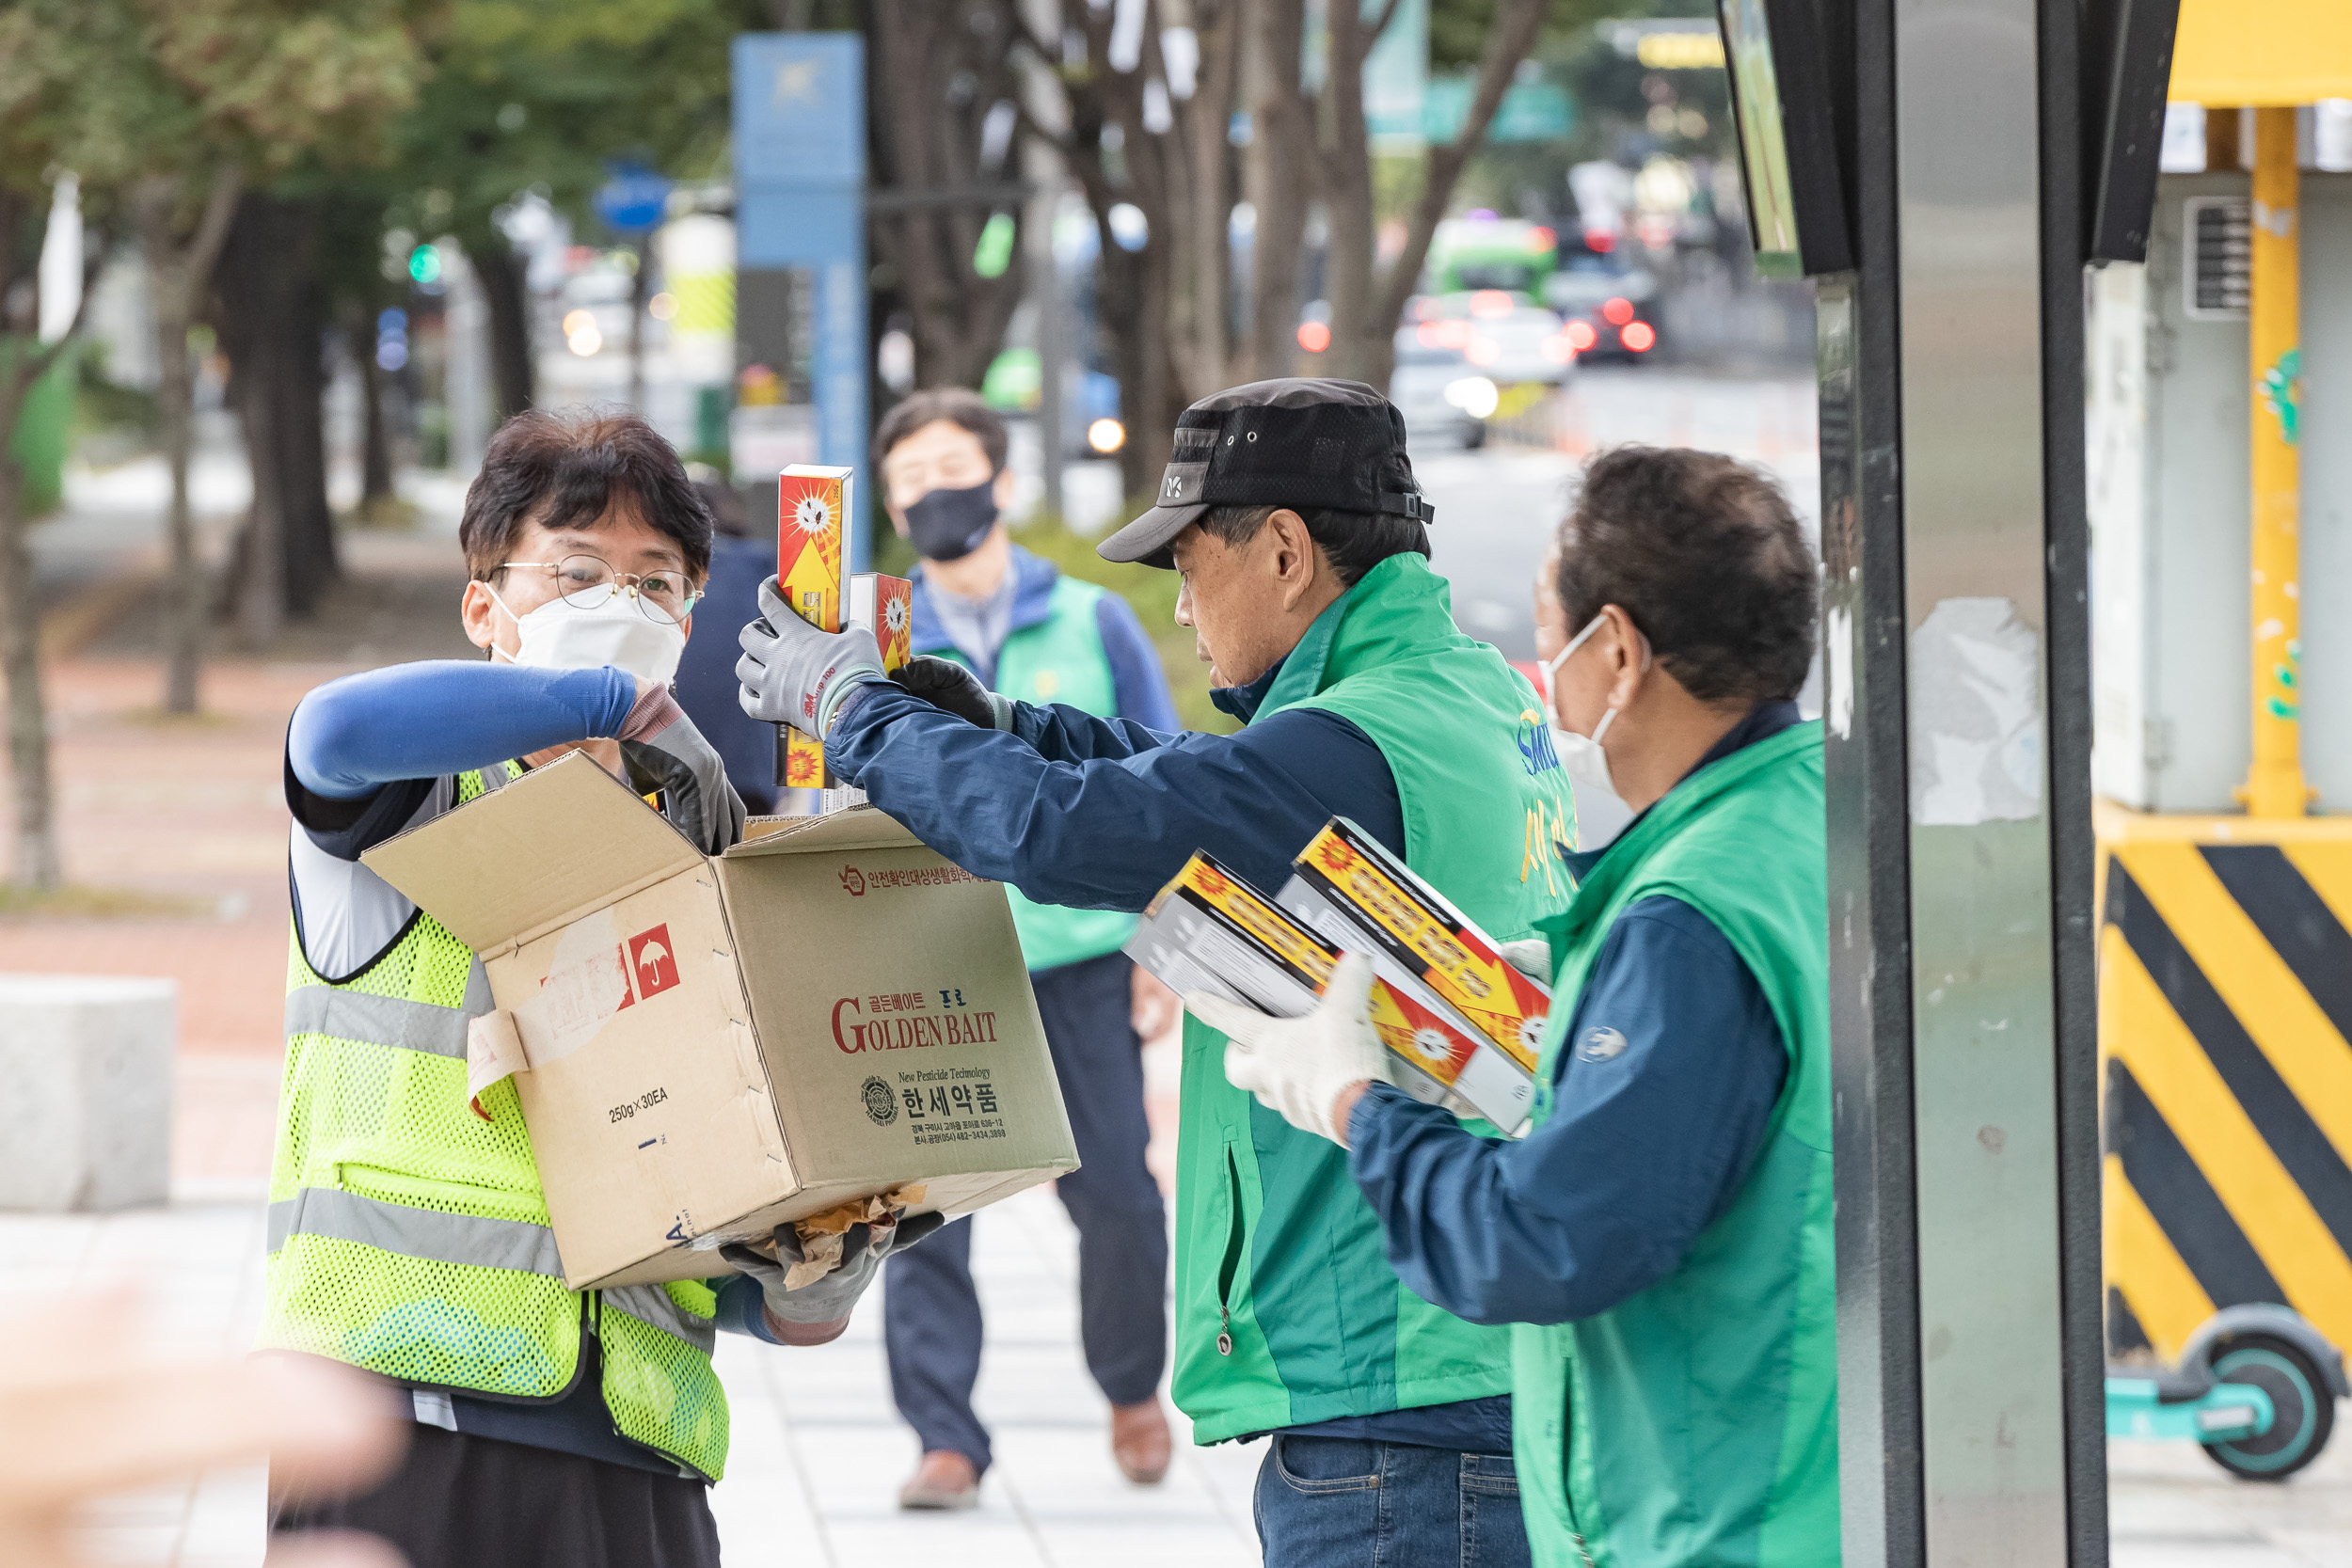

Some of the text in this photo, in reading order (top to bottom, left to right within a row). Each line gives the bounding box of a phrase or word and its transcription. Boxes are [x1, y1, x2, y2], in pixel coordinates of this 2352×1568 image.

[823, 667, 835, 680] 100
[867, 866, 992, 889] 안전확인대상생활화학
[868, 992, 926, 1013] 골든베이트
[832, 997, 997, 1054] GOLDEN BAIT
[898, 1067, 991, 1083] New Pesticide Technology
[901, 1084, 998, 1118] 한세약품
[912, 1124, 924, 1133] 경북
